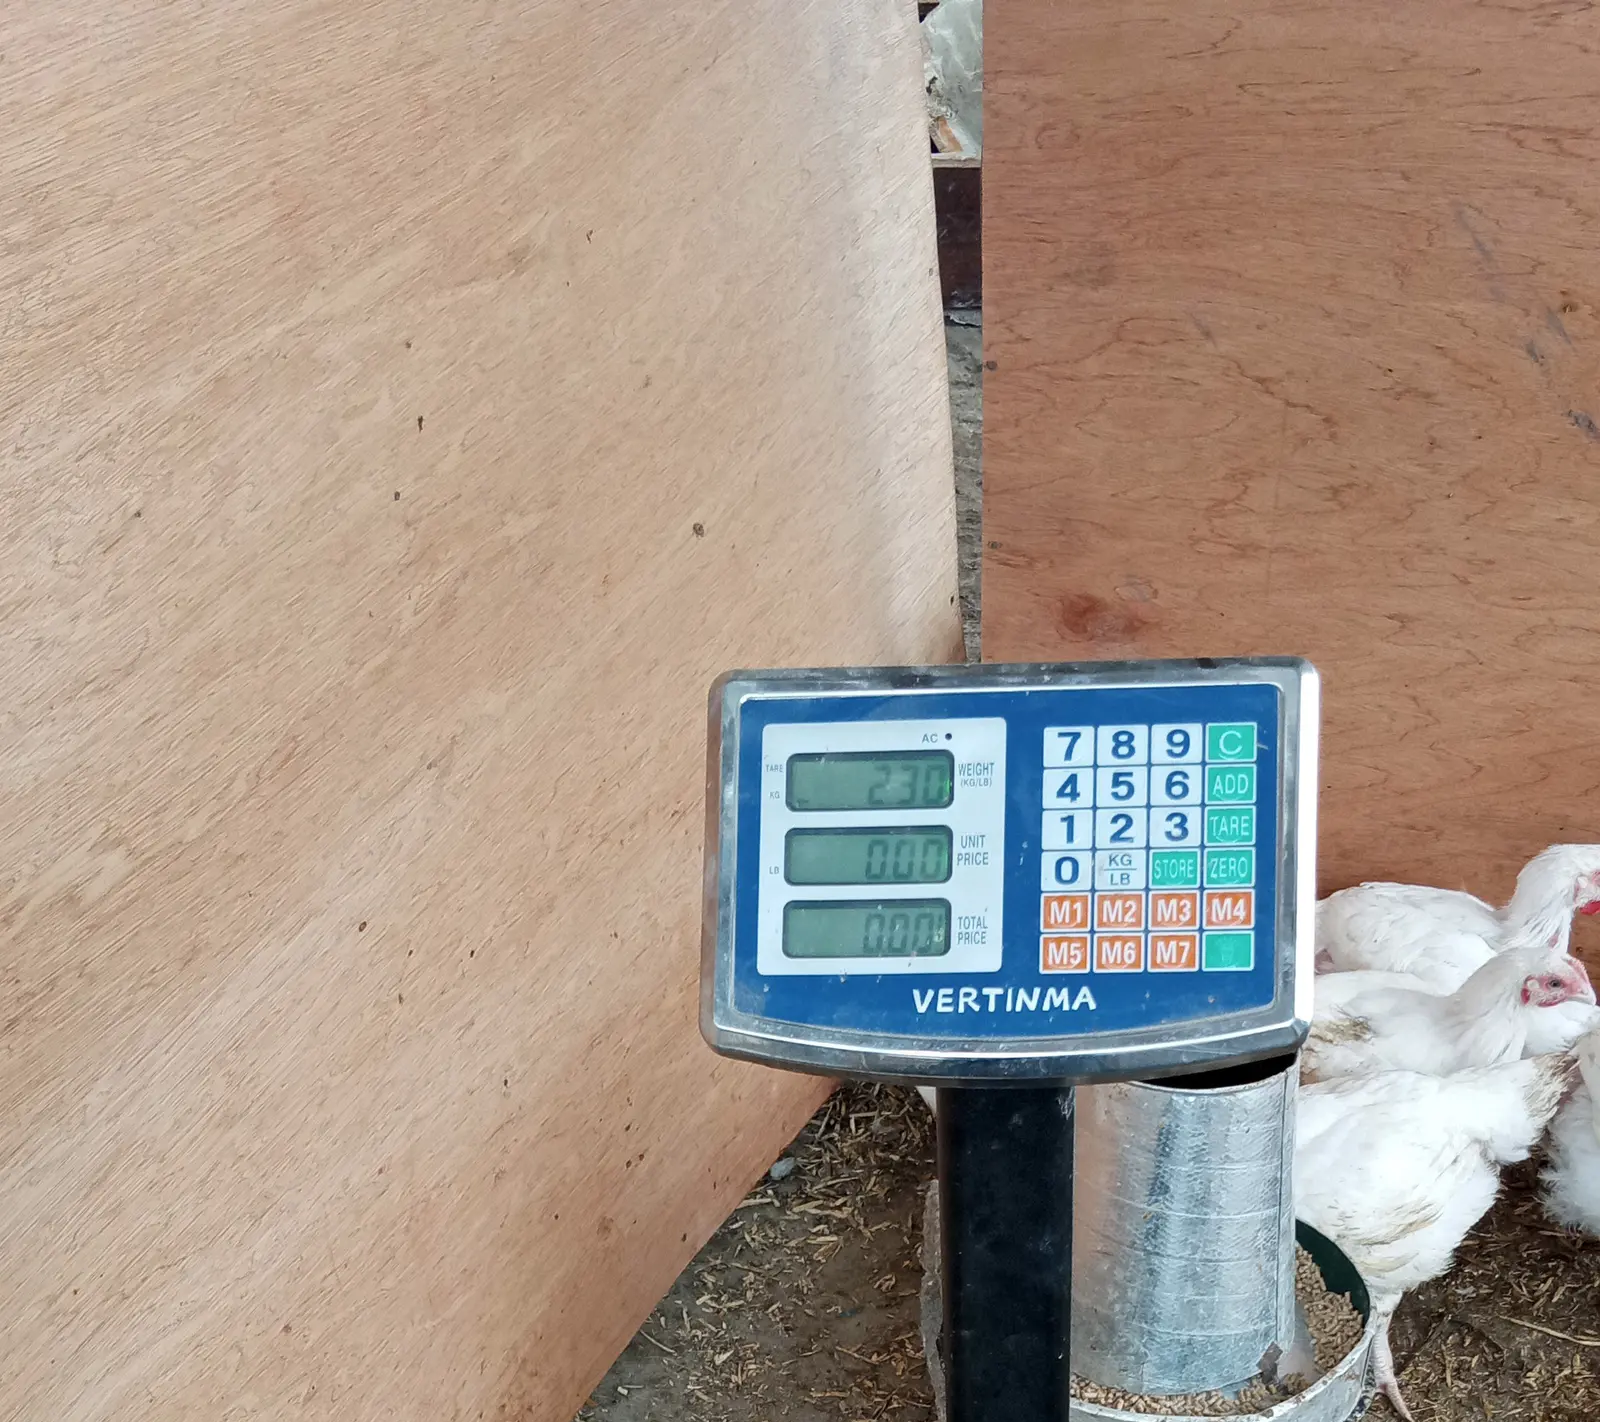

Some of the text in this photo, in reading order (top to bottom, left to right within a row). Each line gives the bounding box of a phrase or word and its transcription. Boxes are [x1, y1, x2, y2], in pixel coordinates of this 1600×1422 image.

[922, 733, 938, 743] AC
[1057, 729, 1243, 761] 7 8 9 C
[766, 764, 783, 773] TARE
[958, 762, 995, 777] WEIGHT
[960, 777, 992, 787] (KG/LB)
[1056, 770, 1249, 803] 4 5 6 ADD
[769, 791, 780, 800] KG
[1060, 812, 1249, 844] 1 2 3 TARE
[960, 835, 986, 849] UNIT
[956, 852, 989, 866] PRICE
[769, 866, 780, 875] LB
[1054, 853, 1248, 885] 0 KG STORE ZERO
[1110, 873, 1131, 886] LB
[1050, 897, 1246, 924] M1 M2 M3 M4
[957, 916, 988, 930] TOTAL
[957, 931, 987, 945] PRICE
[1048, 941, 1190, 965] M5 M6 M7
[912, 986, 1097, 1014] VERTINMA
